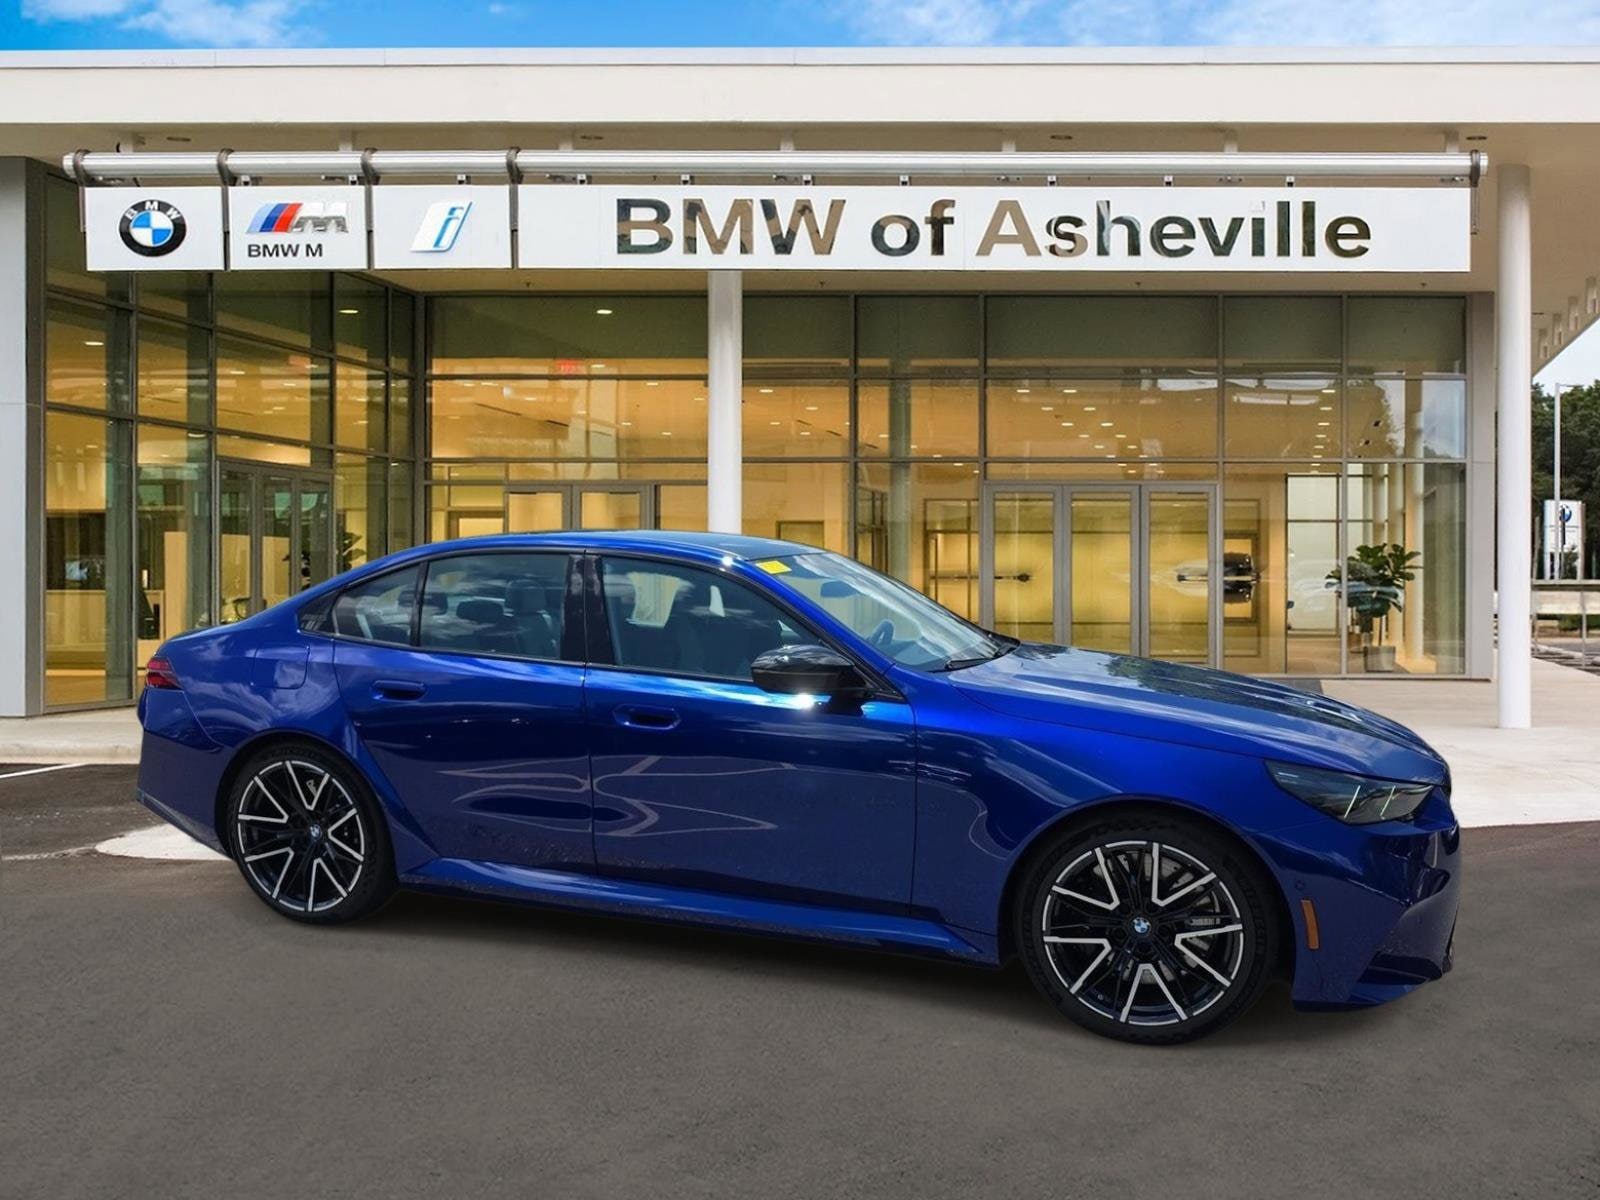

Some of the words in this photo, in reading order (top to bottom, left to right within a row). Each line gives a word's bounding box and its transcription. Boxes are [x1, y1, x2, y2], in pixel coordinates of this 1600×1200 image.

[124, 200, 181, 220] BMW
[615, 197, 847, 256] BMW
[870, 198, 957, 258] of
[975, 199, 1372, 259] Asheville
[247, 243, 300, 258] BMW
[305, 242, 324, 258] M
